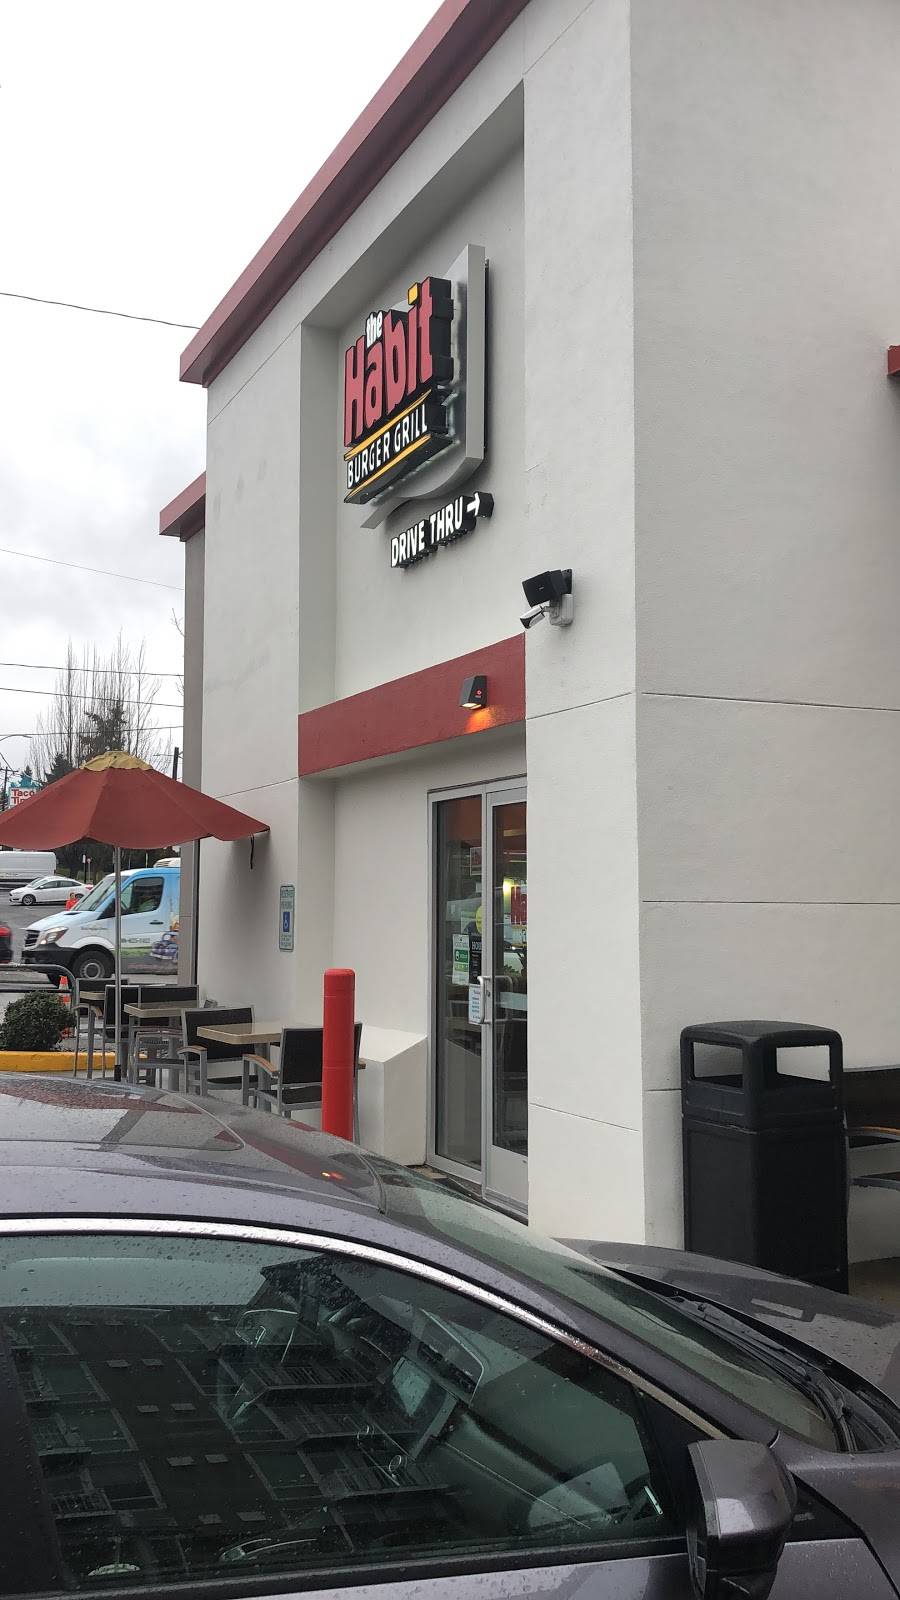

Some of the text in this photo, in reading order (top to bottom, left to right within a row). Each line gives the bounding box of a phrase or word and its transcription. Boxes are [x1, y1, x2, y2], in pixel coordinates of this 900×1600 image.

[344, 277, 433, 447] Habit
[366, 311, 383, 348] the
[347, 403, 428, 489] BURGER GRILL
[391, 496, 463, 567] DRIVE THRU
[11, 789, 35, 798] Taco
